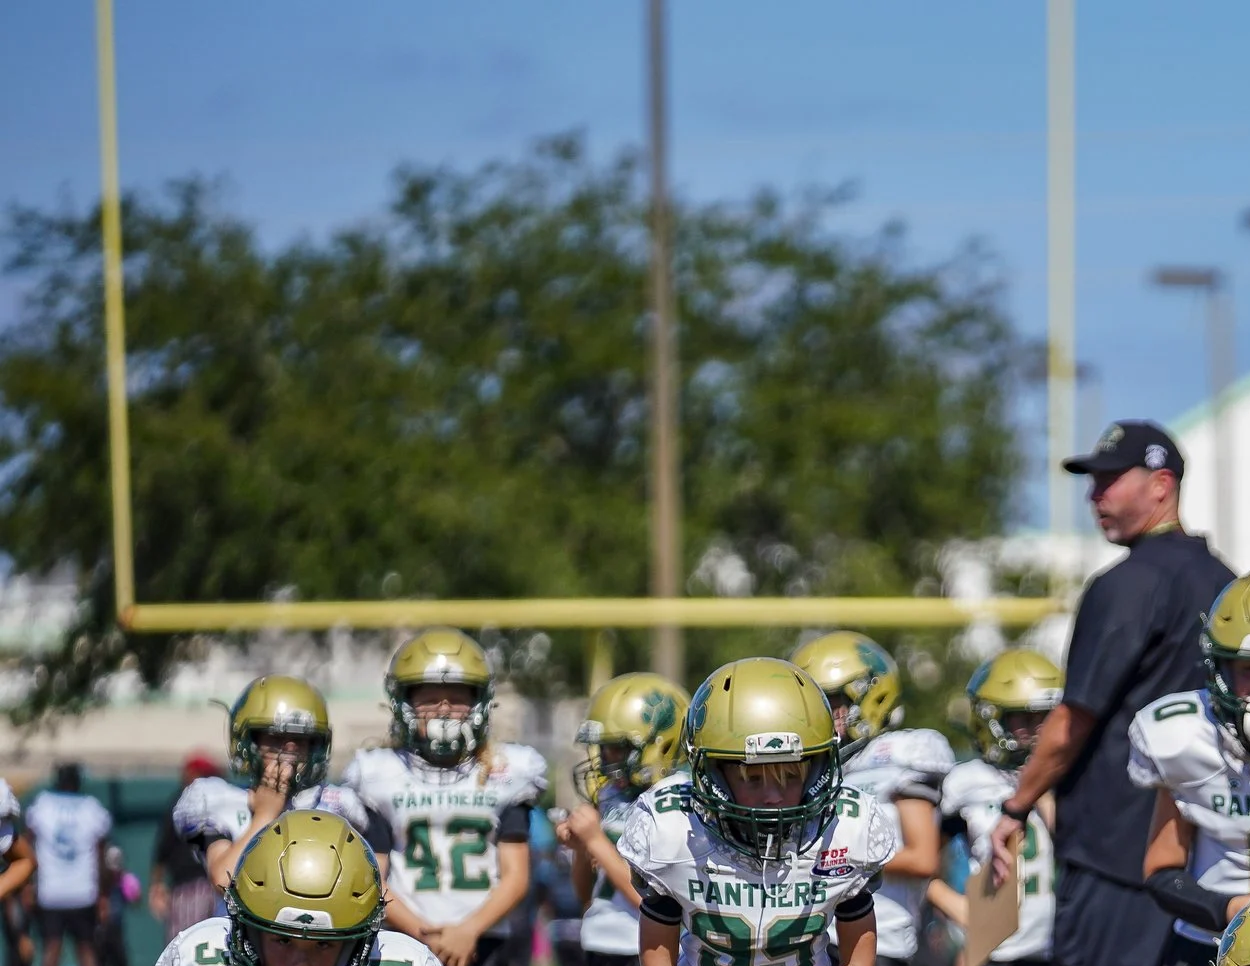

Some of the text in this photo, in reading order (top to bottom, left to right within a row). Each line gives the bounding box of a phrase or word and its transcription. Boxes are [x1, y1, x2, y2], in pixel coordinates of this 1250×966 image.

[405, 815, 494, 891] 42
[820, 847, 849, 861] POP
[687, 878, 829, 909] PANTHERS
